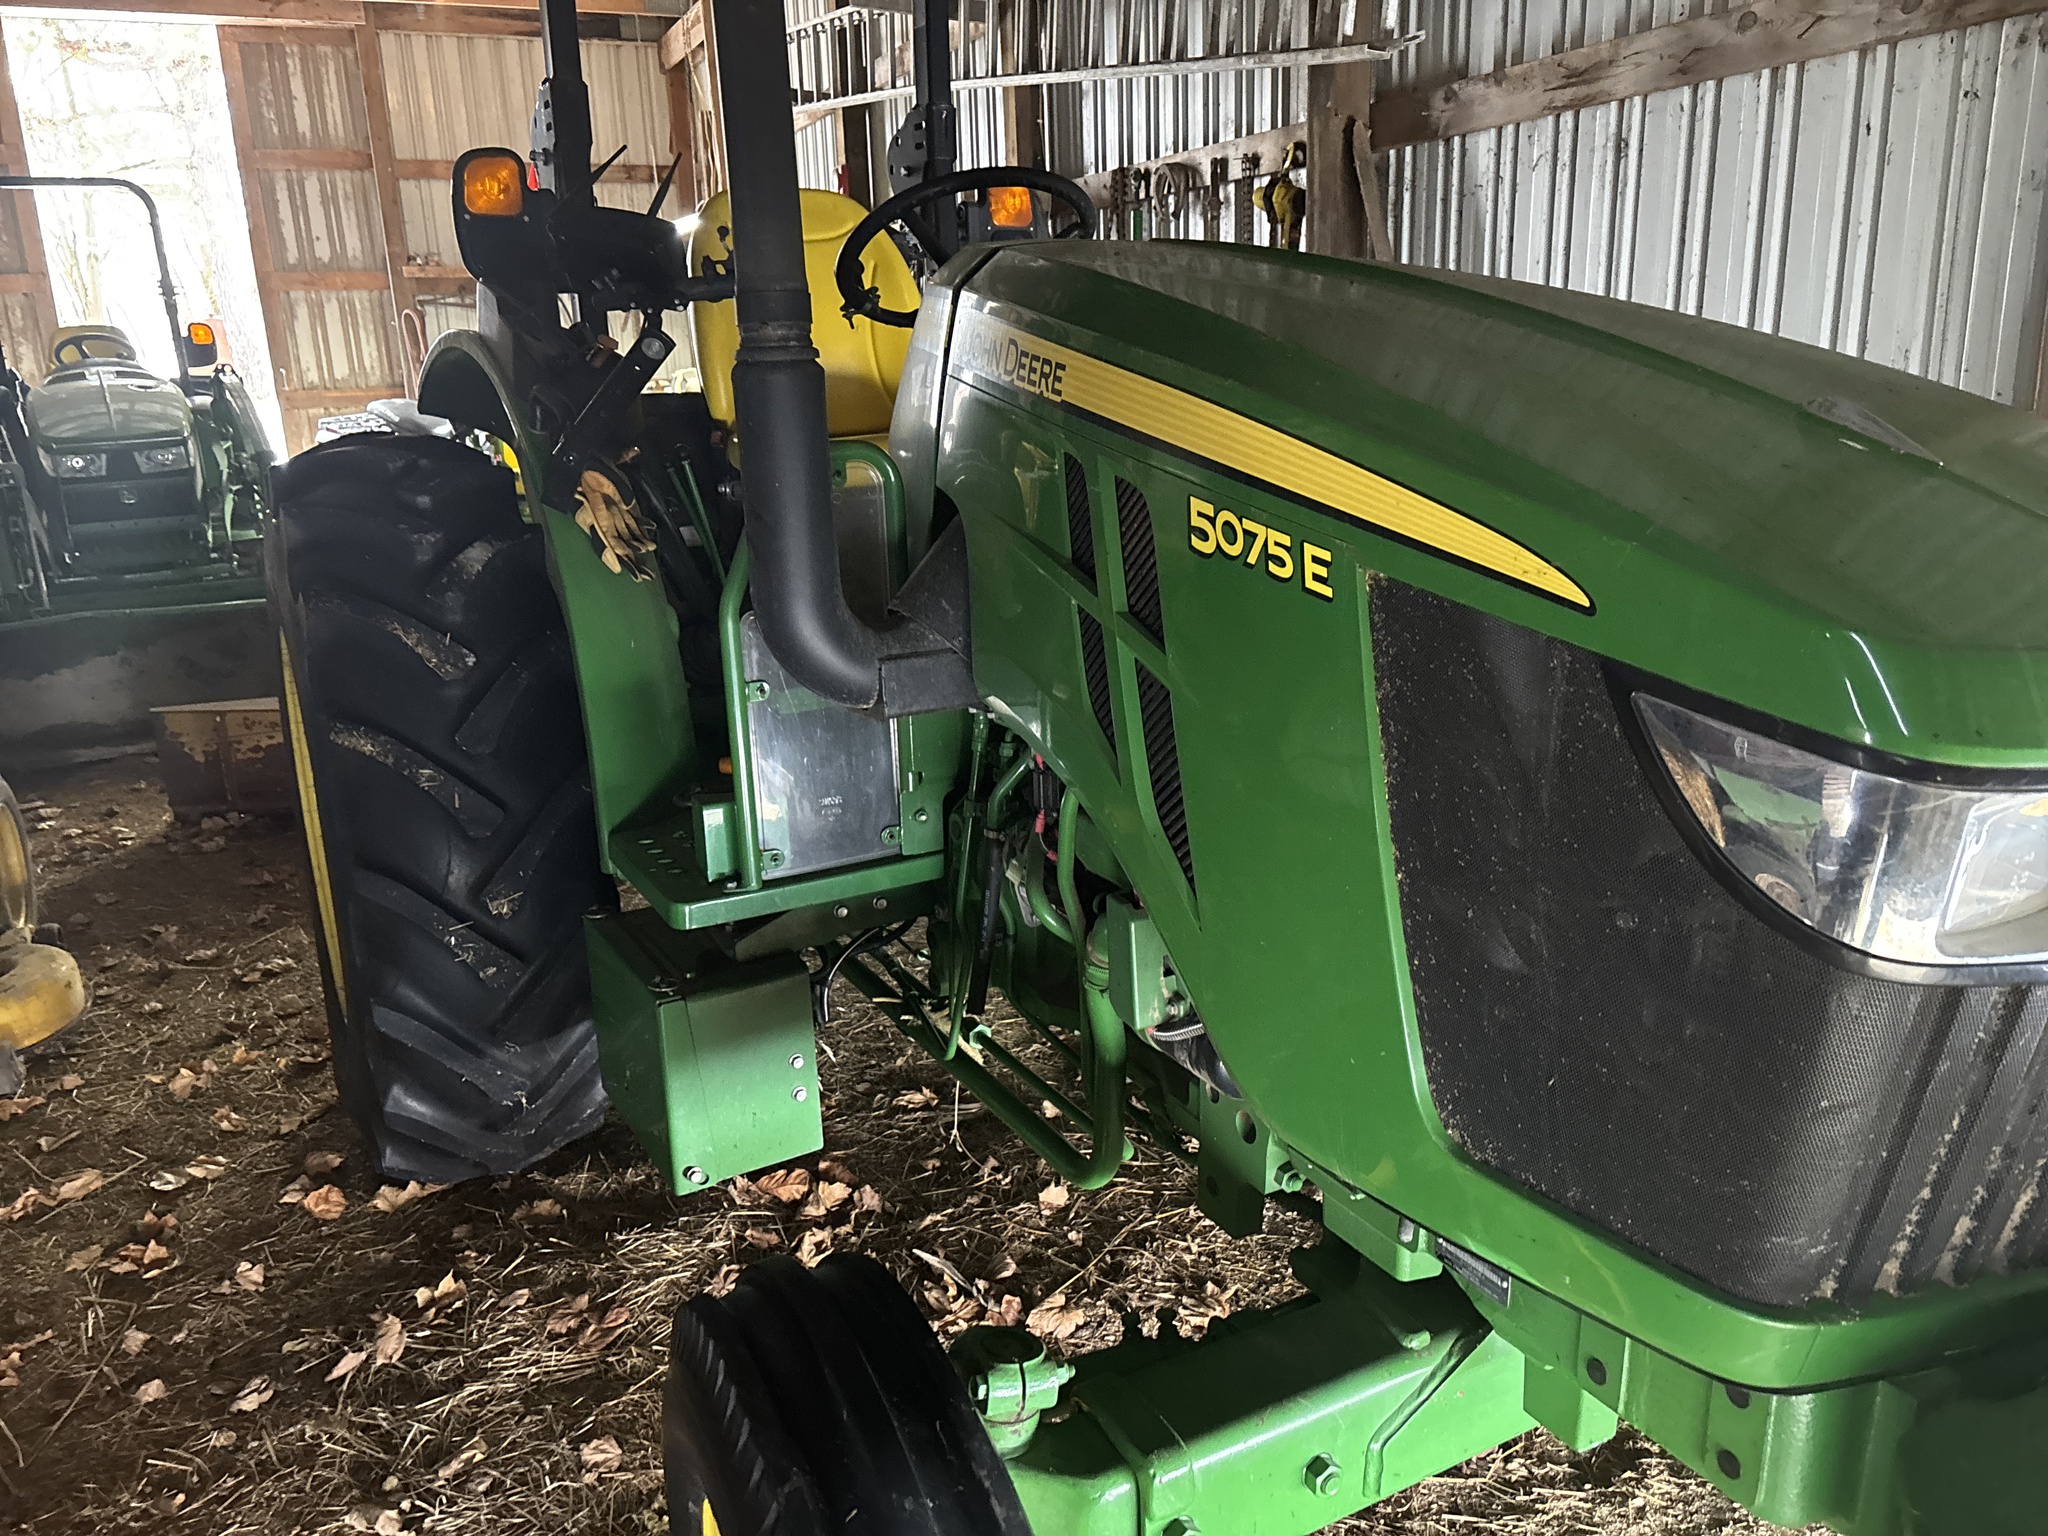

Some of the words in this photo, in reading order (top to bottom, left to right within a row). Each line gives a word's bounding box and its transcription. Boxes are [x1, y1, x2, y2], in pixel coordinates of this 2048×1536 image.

[1004, 338, 1067, 398] DEERE
[1189, 495, 1294, 581] 5075
[1302, 541, 1334, 601] E
